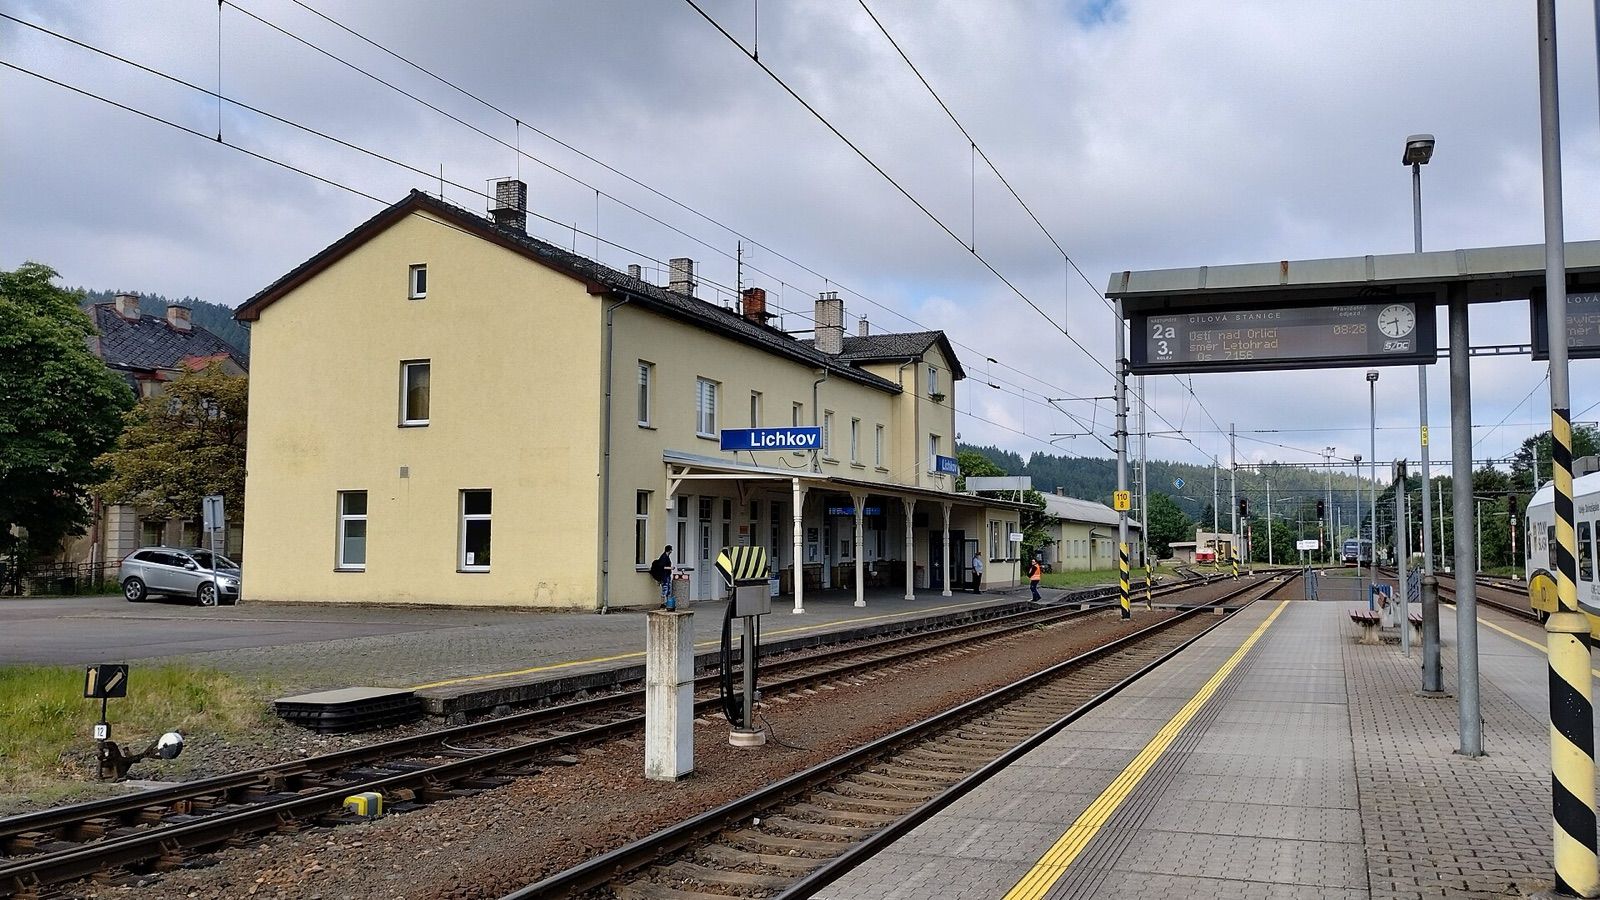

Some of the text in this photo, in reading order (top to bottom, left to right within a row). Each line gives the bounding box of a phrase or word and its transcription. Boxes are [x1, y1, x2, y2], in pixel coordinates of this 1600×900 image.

[1567, 295, 1599, 304] LOVÁ
[1235, 312, 1281, 321] STANICE
[1152, 324, 1176, 339] 2a
[1333, 324, 1367, 335] 08:28
[1218, 330, 1241, 340] nad
[1157, 340, 1173, 355] 3.
[1189, 339, 1279, 352] směr Letohrad
[750, 431, 817, 447] Lichkov
[1116, 493, 1128, 501] 110
[97, 727, 105, 737] 12
